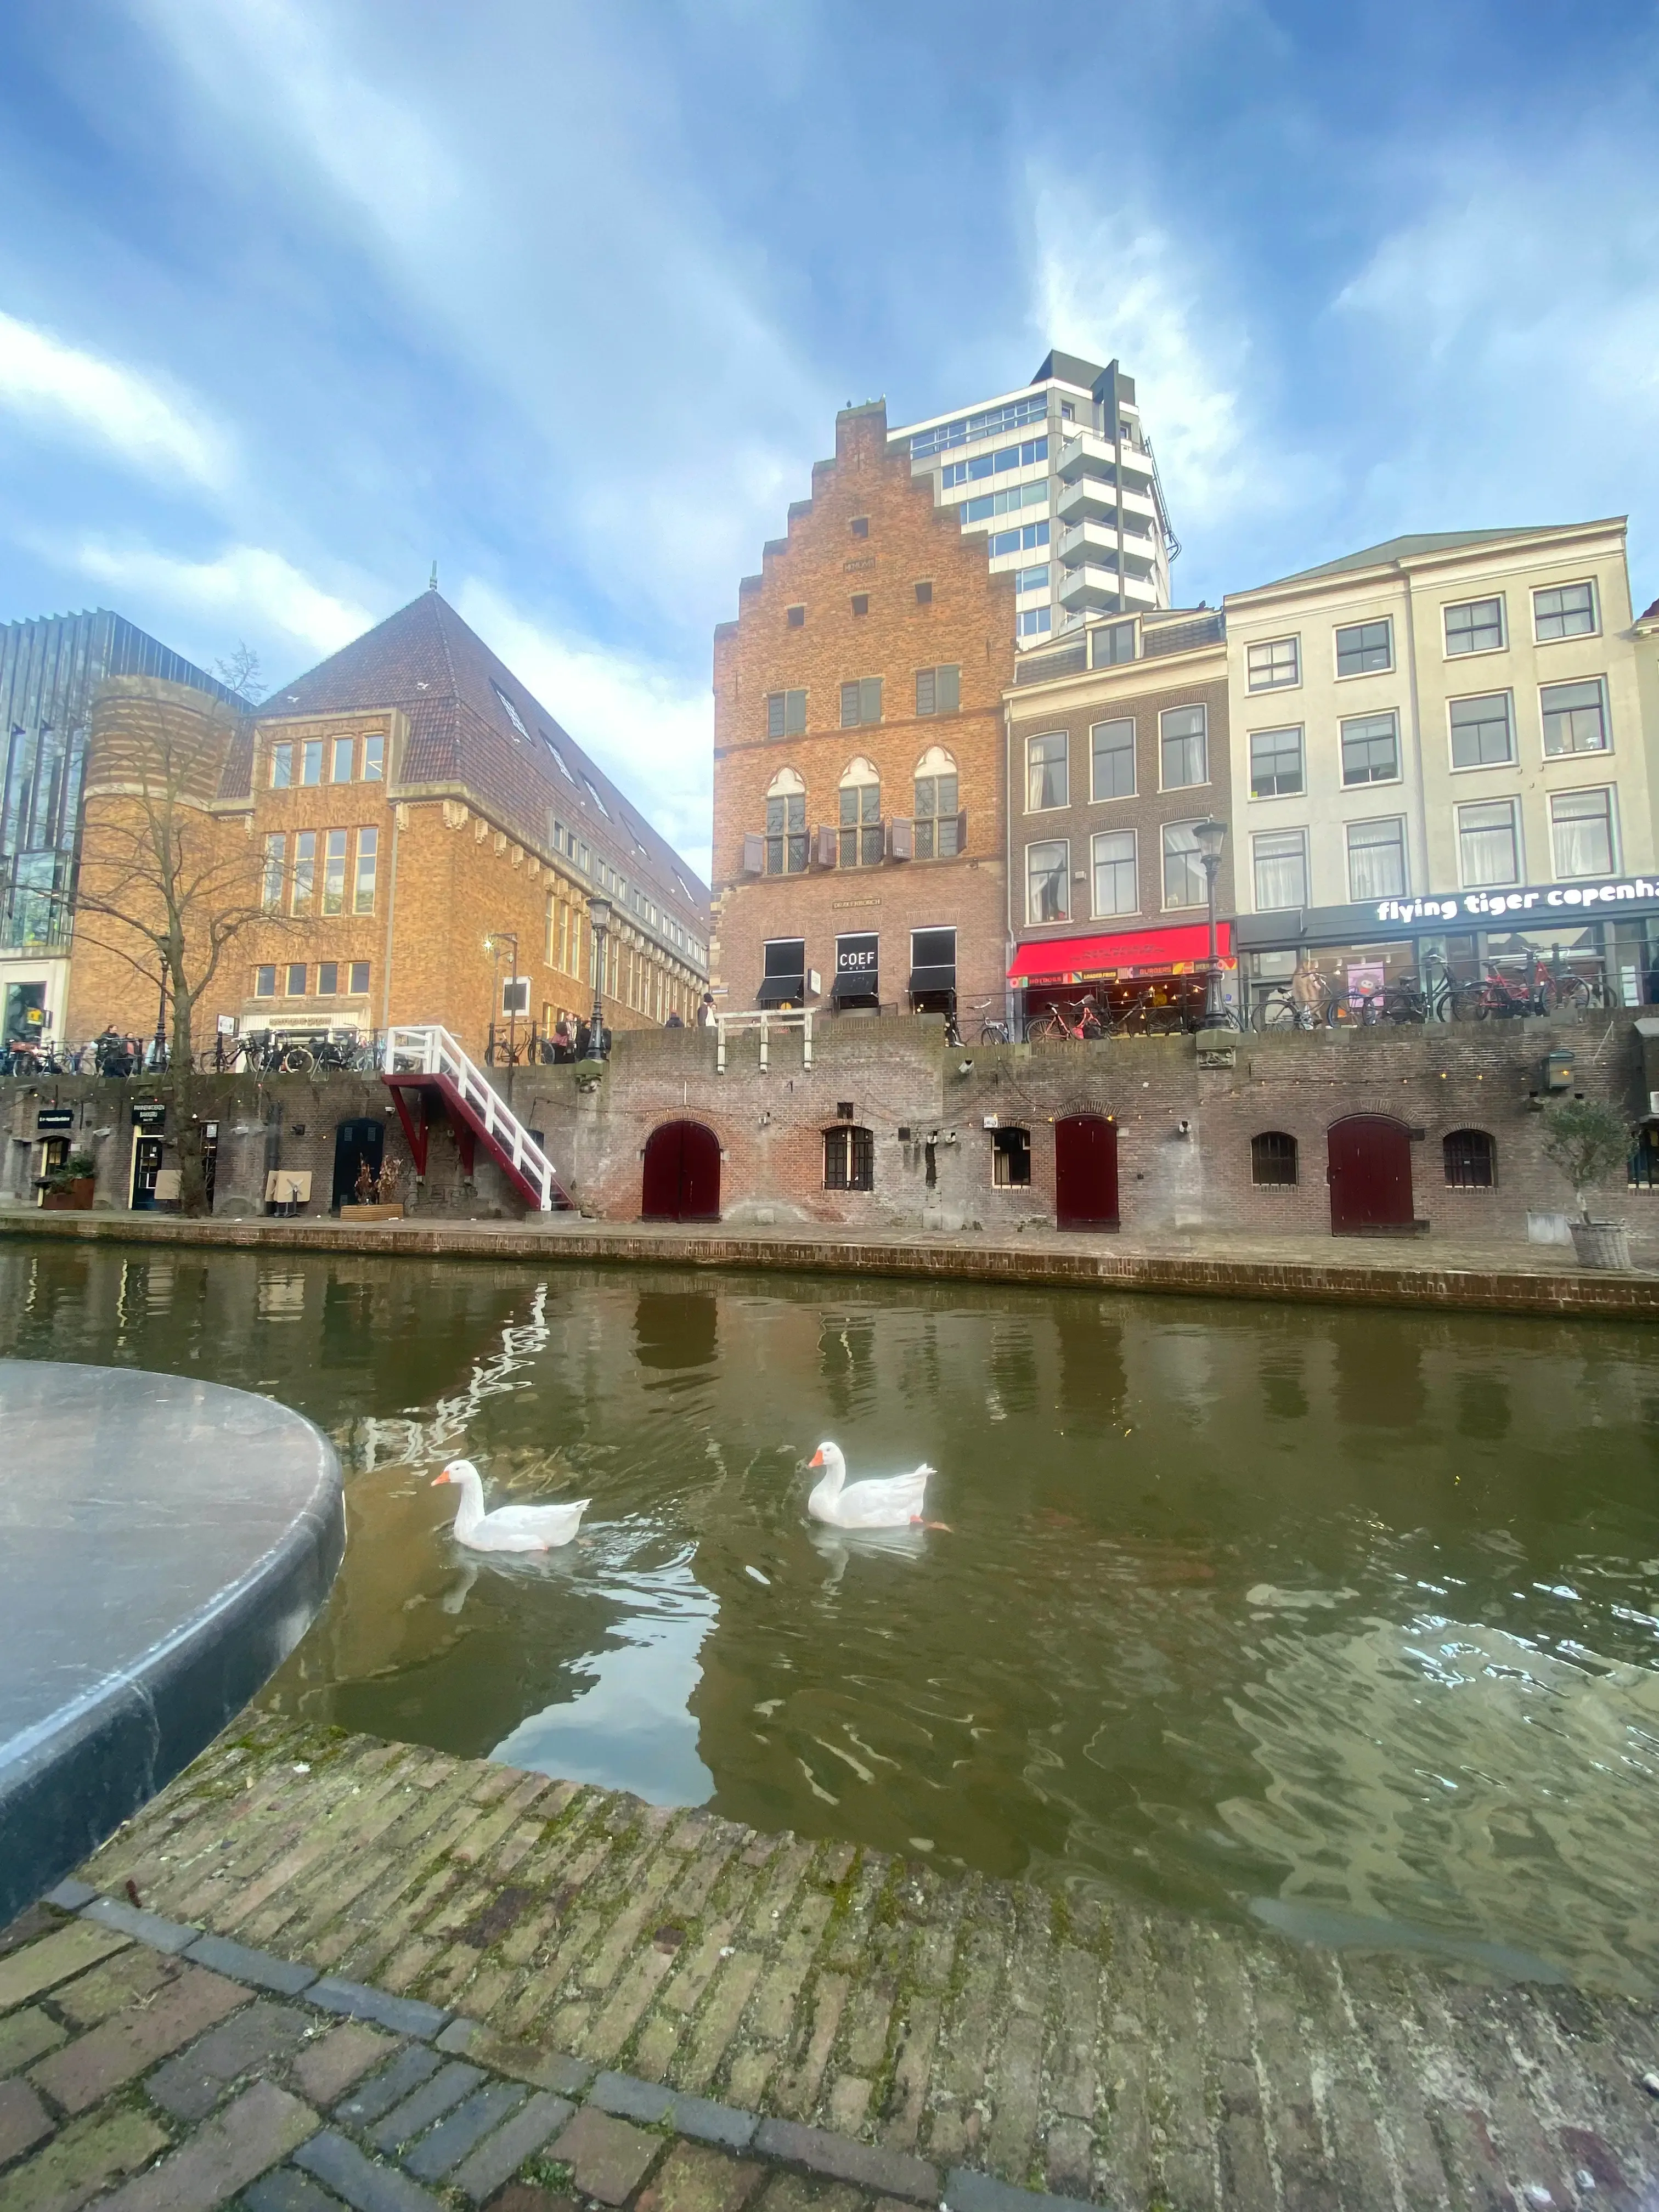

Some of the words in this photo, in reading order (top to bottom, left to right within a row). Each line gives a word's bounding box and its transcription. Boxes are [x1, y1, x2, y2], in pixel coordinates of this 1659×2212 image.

[1377, 898, 1457, 923] flying
[1464, 893, 1539, 916] tiger
[1547, 879, 1659, 906] copenh
[840, 952, 875, 966] COEF
[1139, 967, 1171, 975] BURGERS
